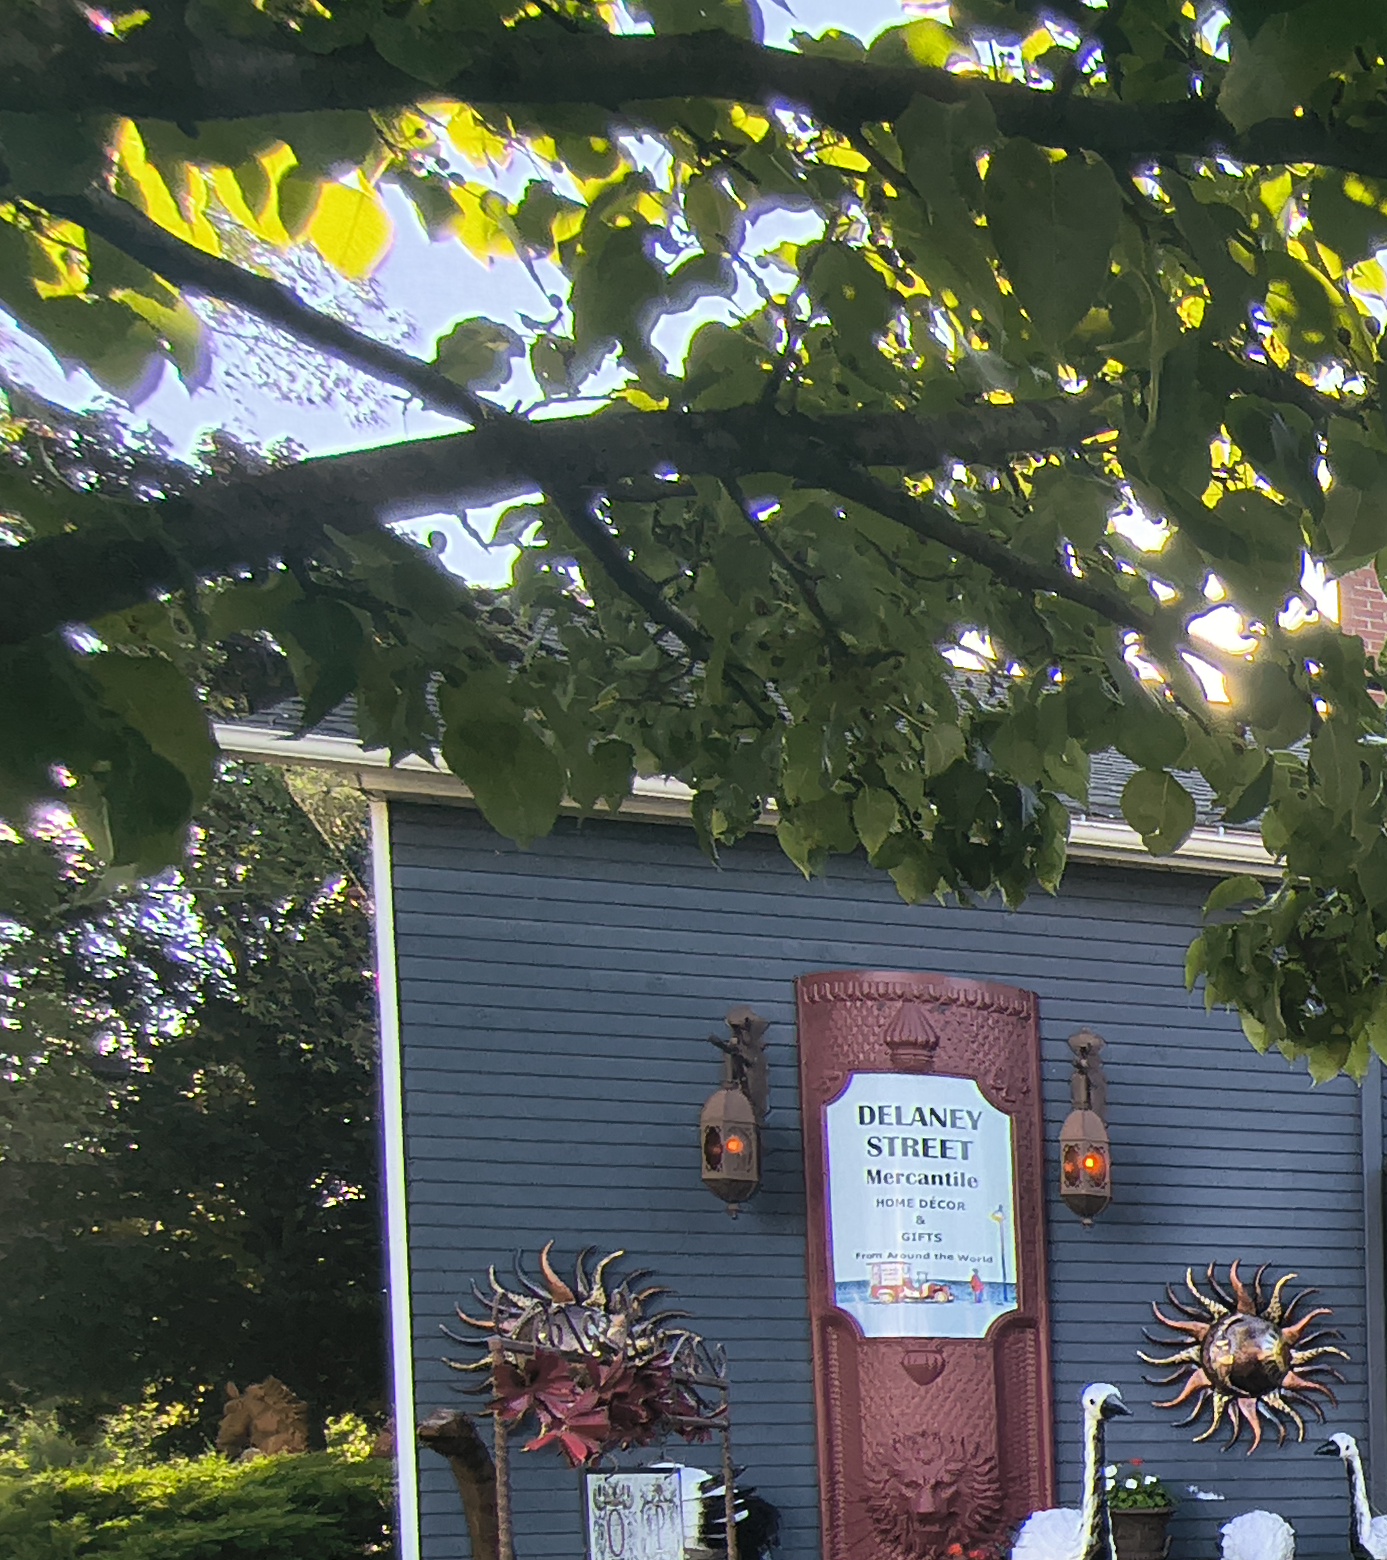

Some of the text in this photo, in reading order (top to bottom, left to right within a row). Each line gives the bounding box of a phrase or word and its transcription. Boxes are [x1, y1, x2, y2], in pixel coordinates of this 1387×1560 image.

[858, 1105, 982, 1130] DELANEY
[867, 1136, 973, 1160] STREET
[866, 1169, 979, 1188] Mercantile
[876, 1196, 966, 1211] HOME DÉCOR
[915, 1215, 925, 1225] &
[901, 1232, 943, 1243] GIFTS
[855, 1252, 993, 1263] From Around the World
